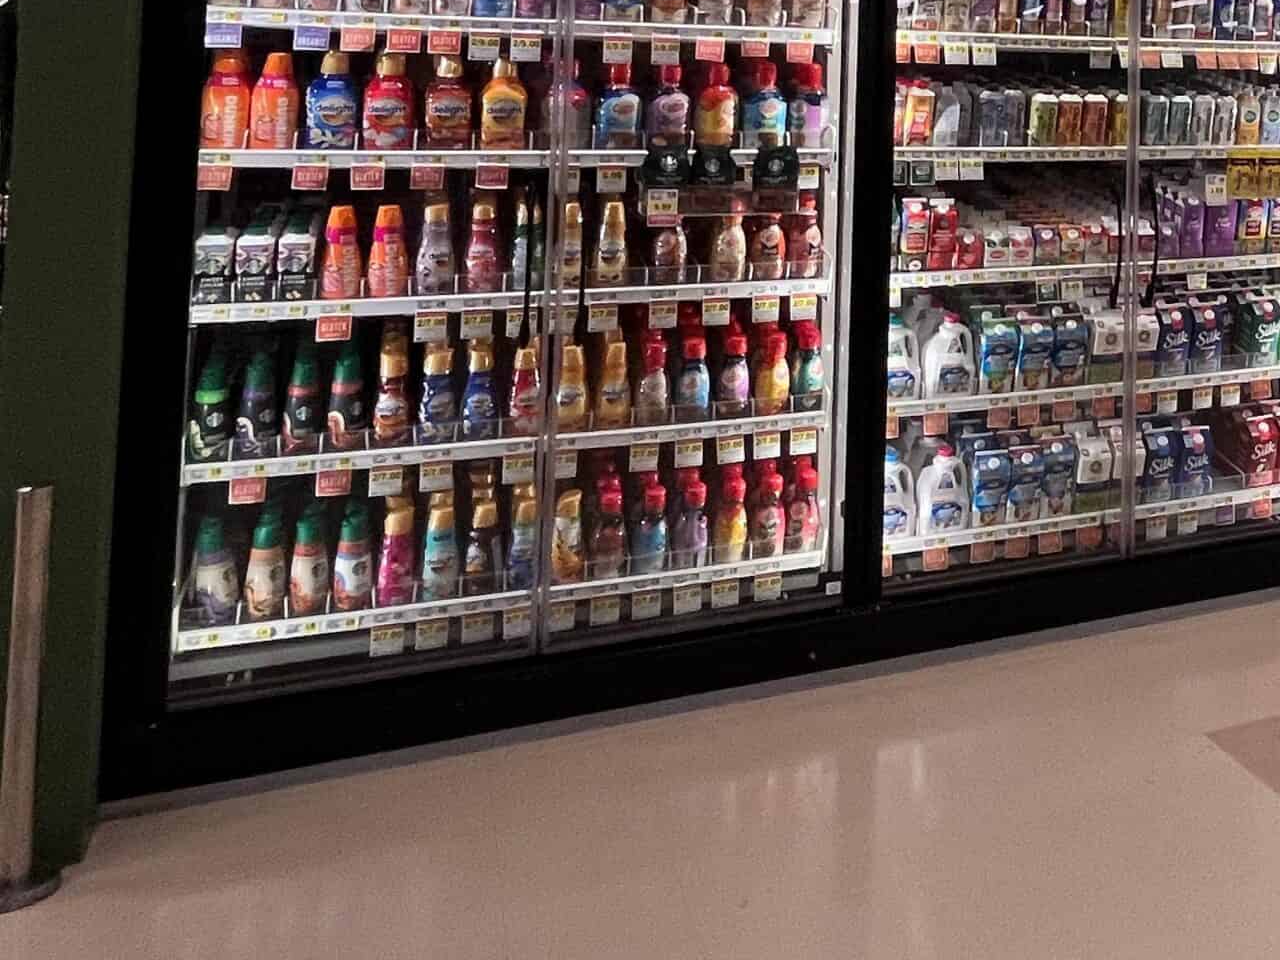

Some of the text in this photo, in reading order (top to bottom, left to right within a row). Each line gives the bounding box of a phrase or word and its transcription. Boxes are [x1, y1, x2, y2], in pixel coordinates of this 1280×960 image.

[1163, 330, 1190, 348] Silk
[1197, 327, 1222, 346] Silk
[1255, 319, 1280, 340] Silk
[1252, 441, 1276, 461] Silk
[1149, 456, 1176, 476] Silk
[1184, 453, 1209, 472] Silk
